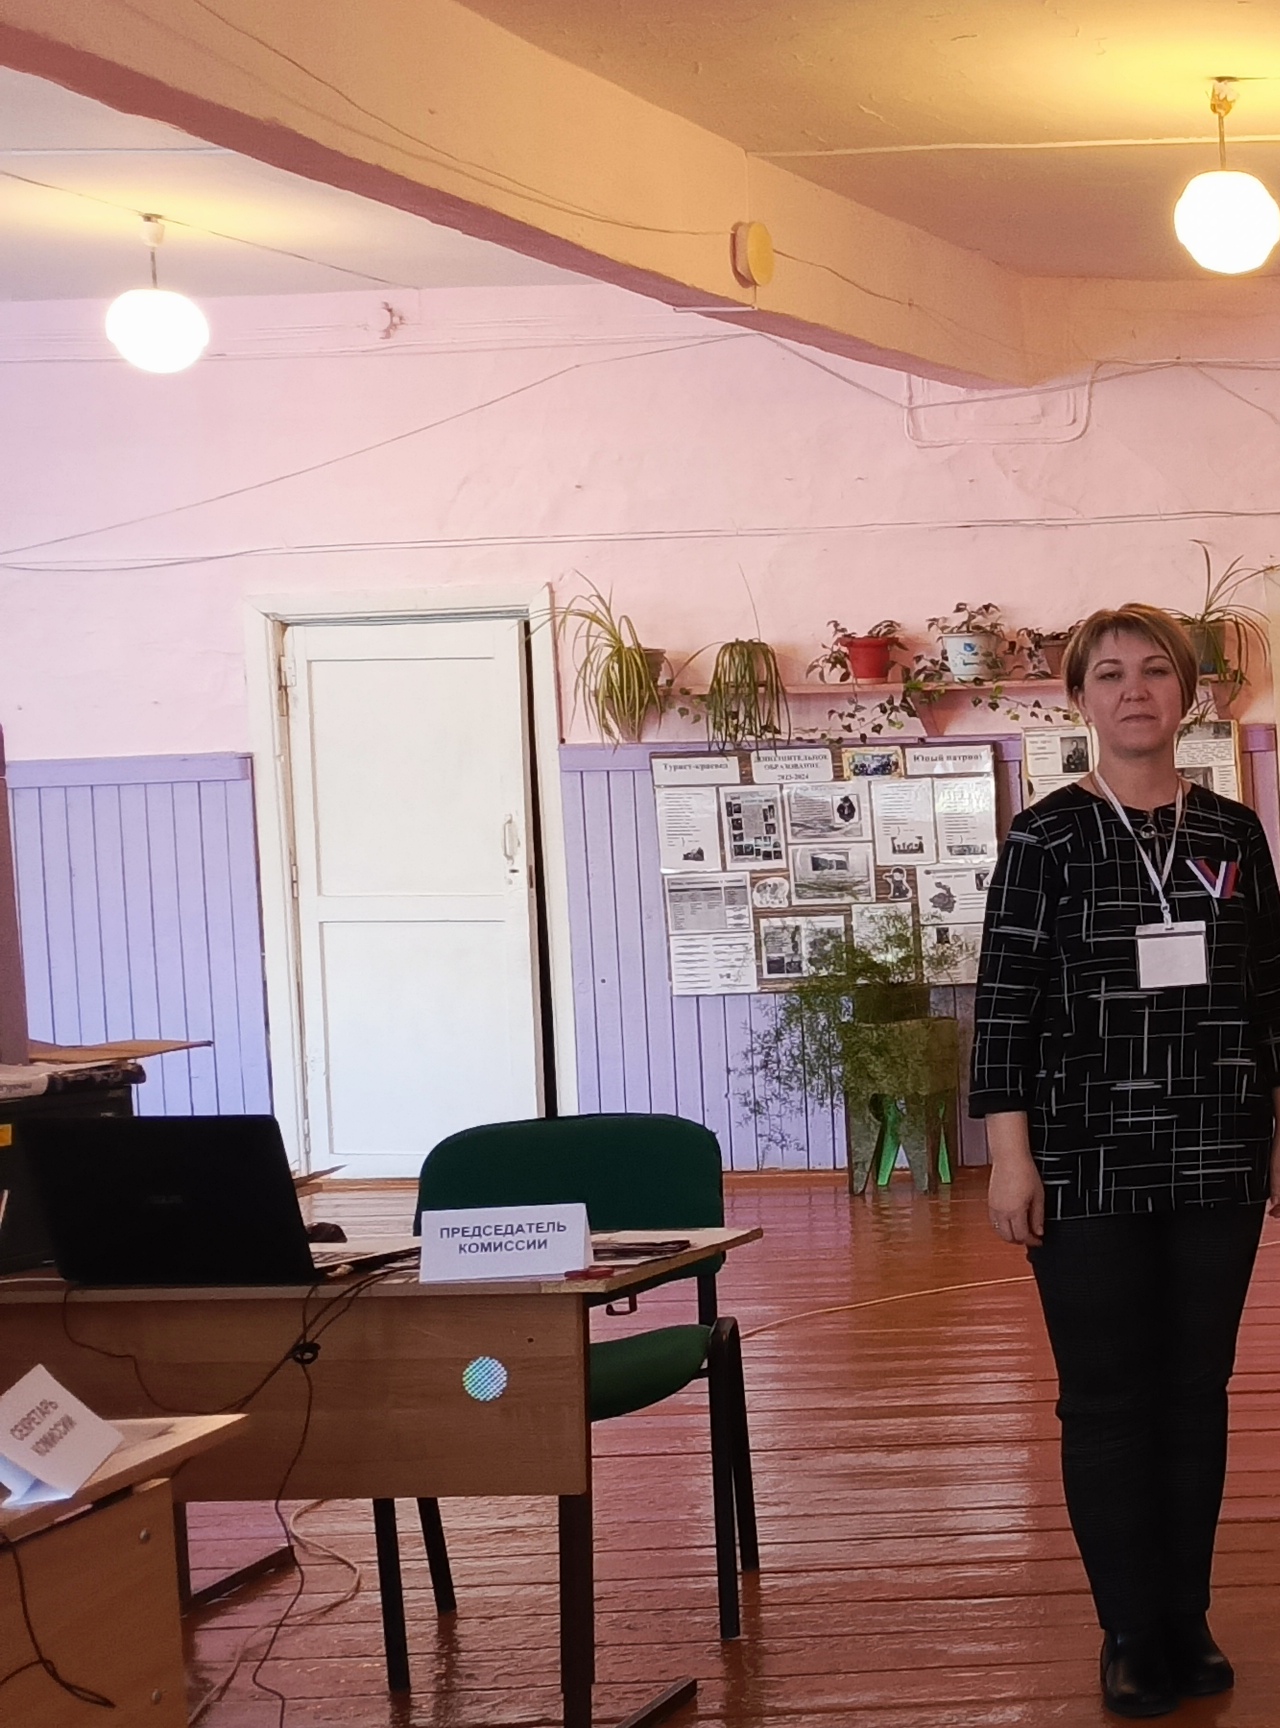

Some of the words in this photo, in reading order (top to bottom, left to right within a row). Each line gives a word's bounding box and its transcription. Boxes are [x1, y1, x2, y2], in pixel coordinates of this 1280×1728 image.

[913, 754, 944, 763] Юный
[440, 1221, 567, 1239] ПРЕДСЕДАТЕЛЬ
[459, 1238, 548, 1255] КОМИССИИ
[9, 1399, 59, 1441] СЕКРЕТАРЬ
